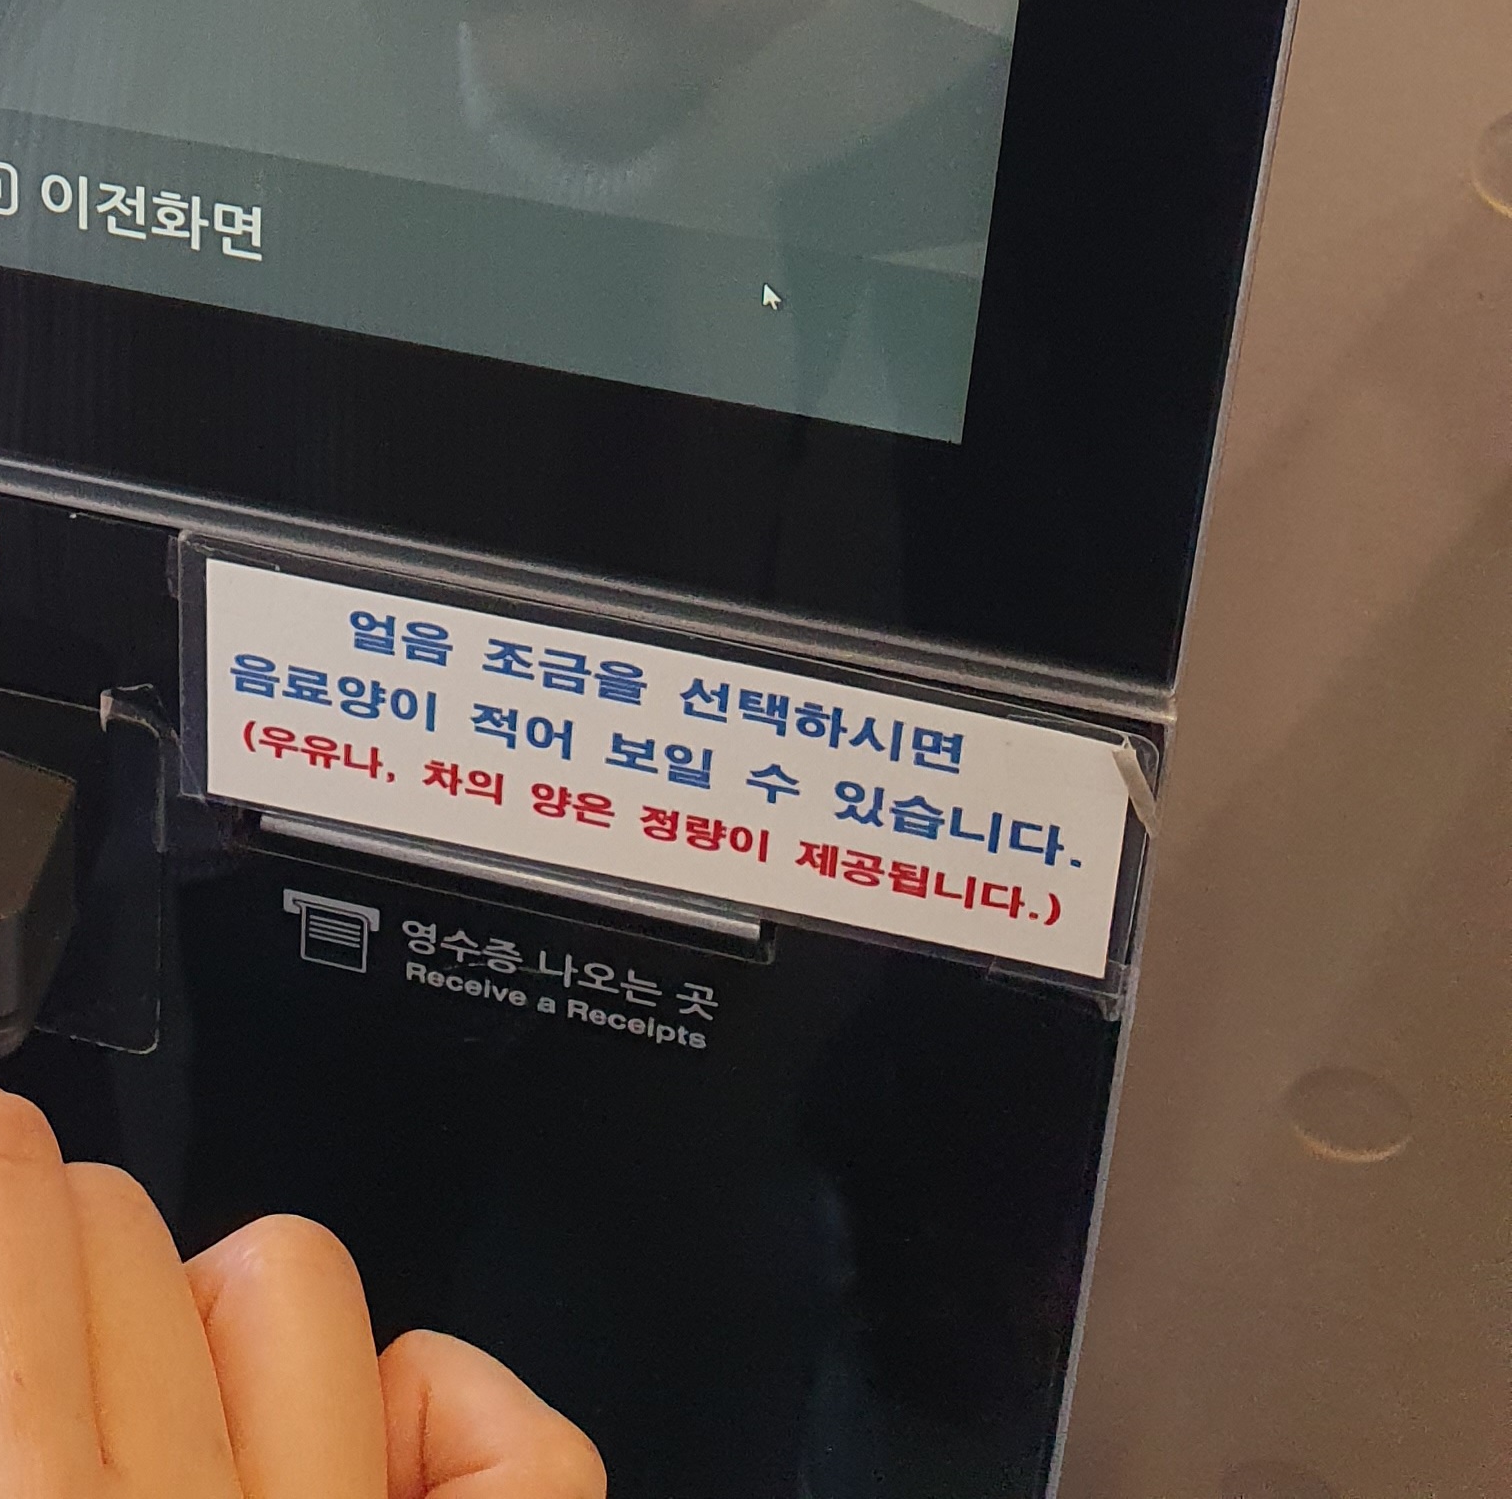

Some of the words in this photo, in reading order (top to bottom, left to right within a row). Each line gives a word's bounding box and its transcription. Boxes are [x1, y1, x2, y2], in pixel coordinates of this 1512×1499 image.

[41, 174, 262, 262] 이전화면
[349, 609, 453, 667] 얼음
[481, 637, 648, 706] 조금을
[679, 677, 964, 774] 선택하시면
[230, 652, 437, 732] 음료양이
[470, 702, 573, 761] 적어
[605, 732, 713, 790] 보일
[746, 763, 800, 804] 수
[834, 779, 1083, 868] 있습니다.
[242, 719, 395, 783] (우유나,
[423, 758, 504, 805] 차의
[530, 782, 616, 828] 양은
[640, 804, 770, 863] 정량이
[795, 839, 1062, 926] 제공됩니다.)
[402, 920, 523, 974] 영수증
[538, 950, 663, 1007] 나오는
[676, 982, 718, 1021] 곳
[406, 961, 528, 1007] Receive
[537, 996, 556, 1015] a
[567, 1001, 707, 1049] Receipts
